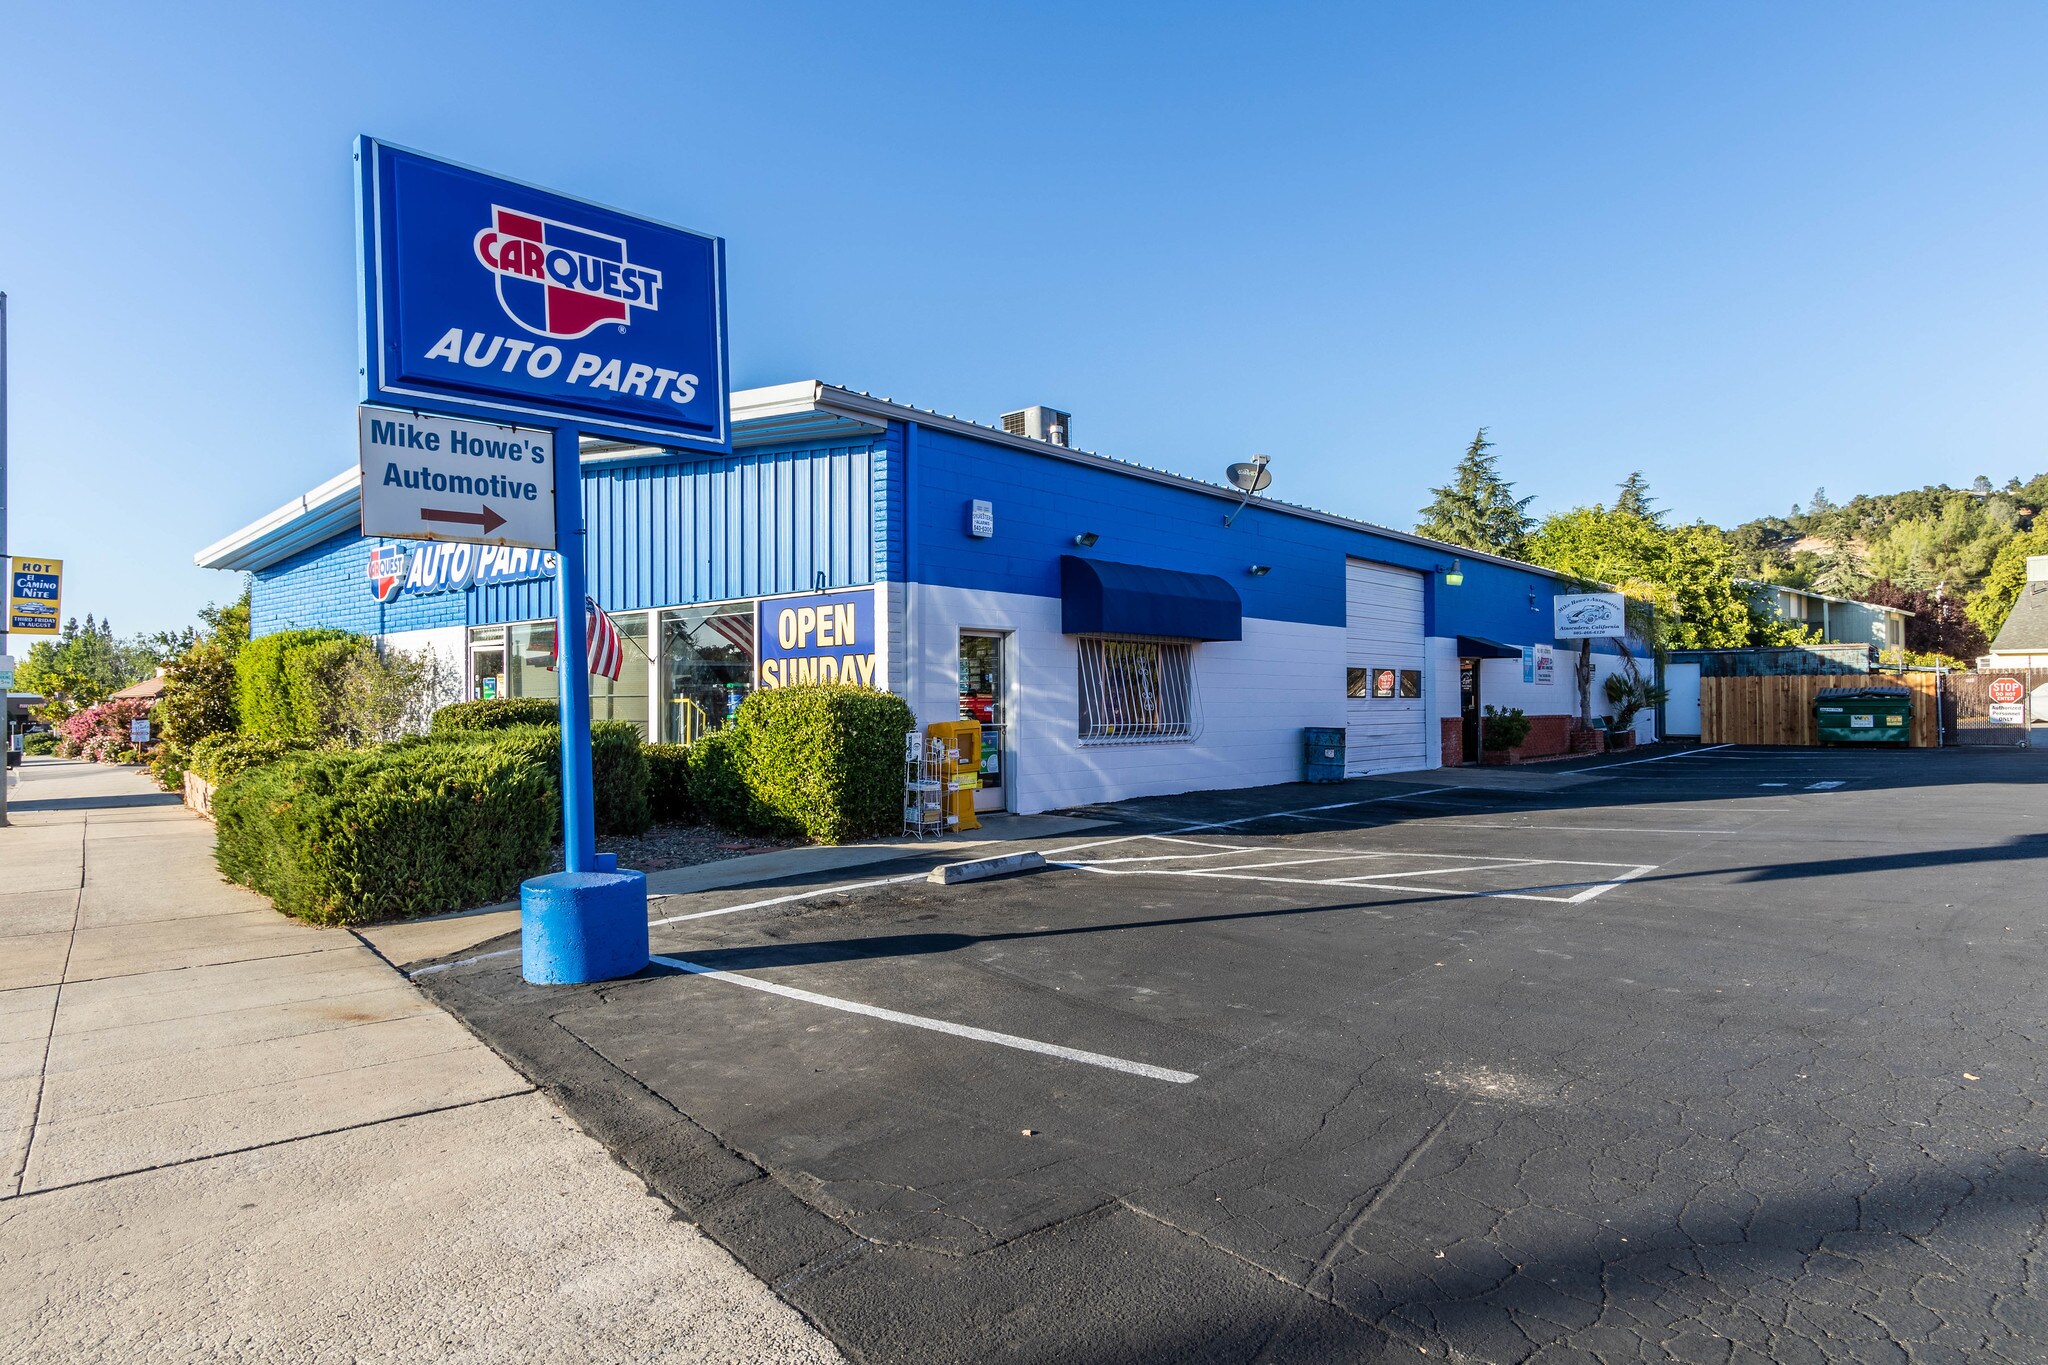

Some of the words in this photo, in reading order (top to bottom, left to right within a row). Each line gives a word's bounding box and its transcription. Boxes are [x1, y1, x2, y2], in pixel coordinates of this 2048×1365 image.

[479, 232, 658, 306] CARQUEST
[424, 327, 563, 379] AUTO
[566, 352, 699, 404] PARTS
[371, 419, 440, 452] Mike
[451, 430, 545, 464] Howe's
[383, 462, 538, 501] Automotive
[22, 562, 52, 573] HOT
[367, 557, 403, 578] CARQUEST
[406, 541, 471, 589] AUTO
[1591, 597, 1621, 611] Automotive
[778, 602, 856, 650] OPEN
[761, 653, 876, 690] SUNDAY
[1993, 682, 2019, 692] STOP
